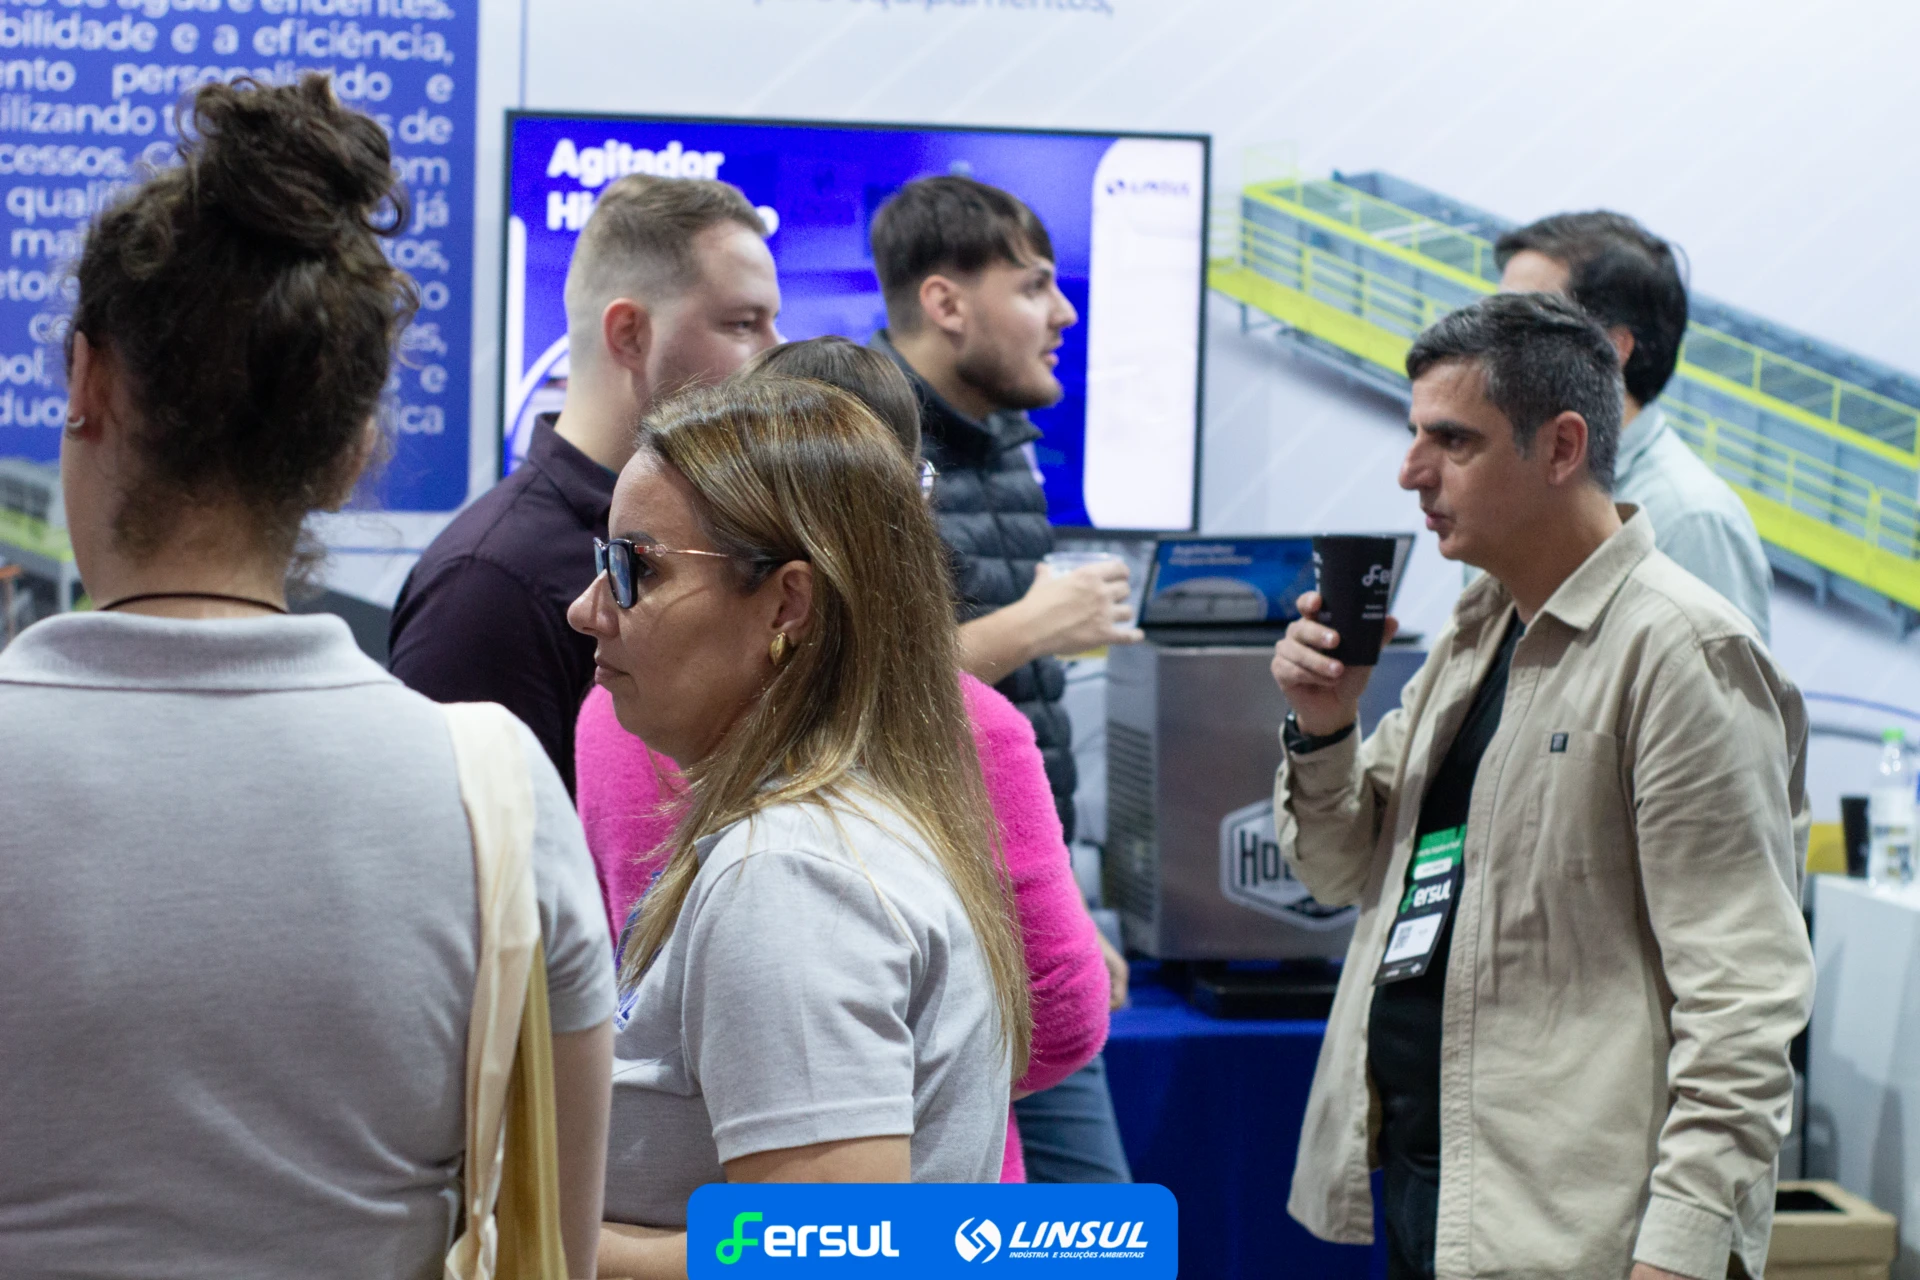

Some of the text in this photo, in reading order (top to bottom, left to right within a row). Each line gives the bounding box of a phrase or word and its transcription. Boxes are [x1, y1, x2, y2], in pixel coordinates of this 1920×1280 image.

[170, 22, 199, 54] e
[212, 24, 239, 55] a
[252, 17, 455, 67] eficiência,
[425, 73, 454, 104] e
[398, 107, 453, 145] de
[547, 138, 725, 188] Agitador
[420, 364, 448, 393] e
